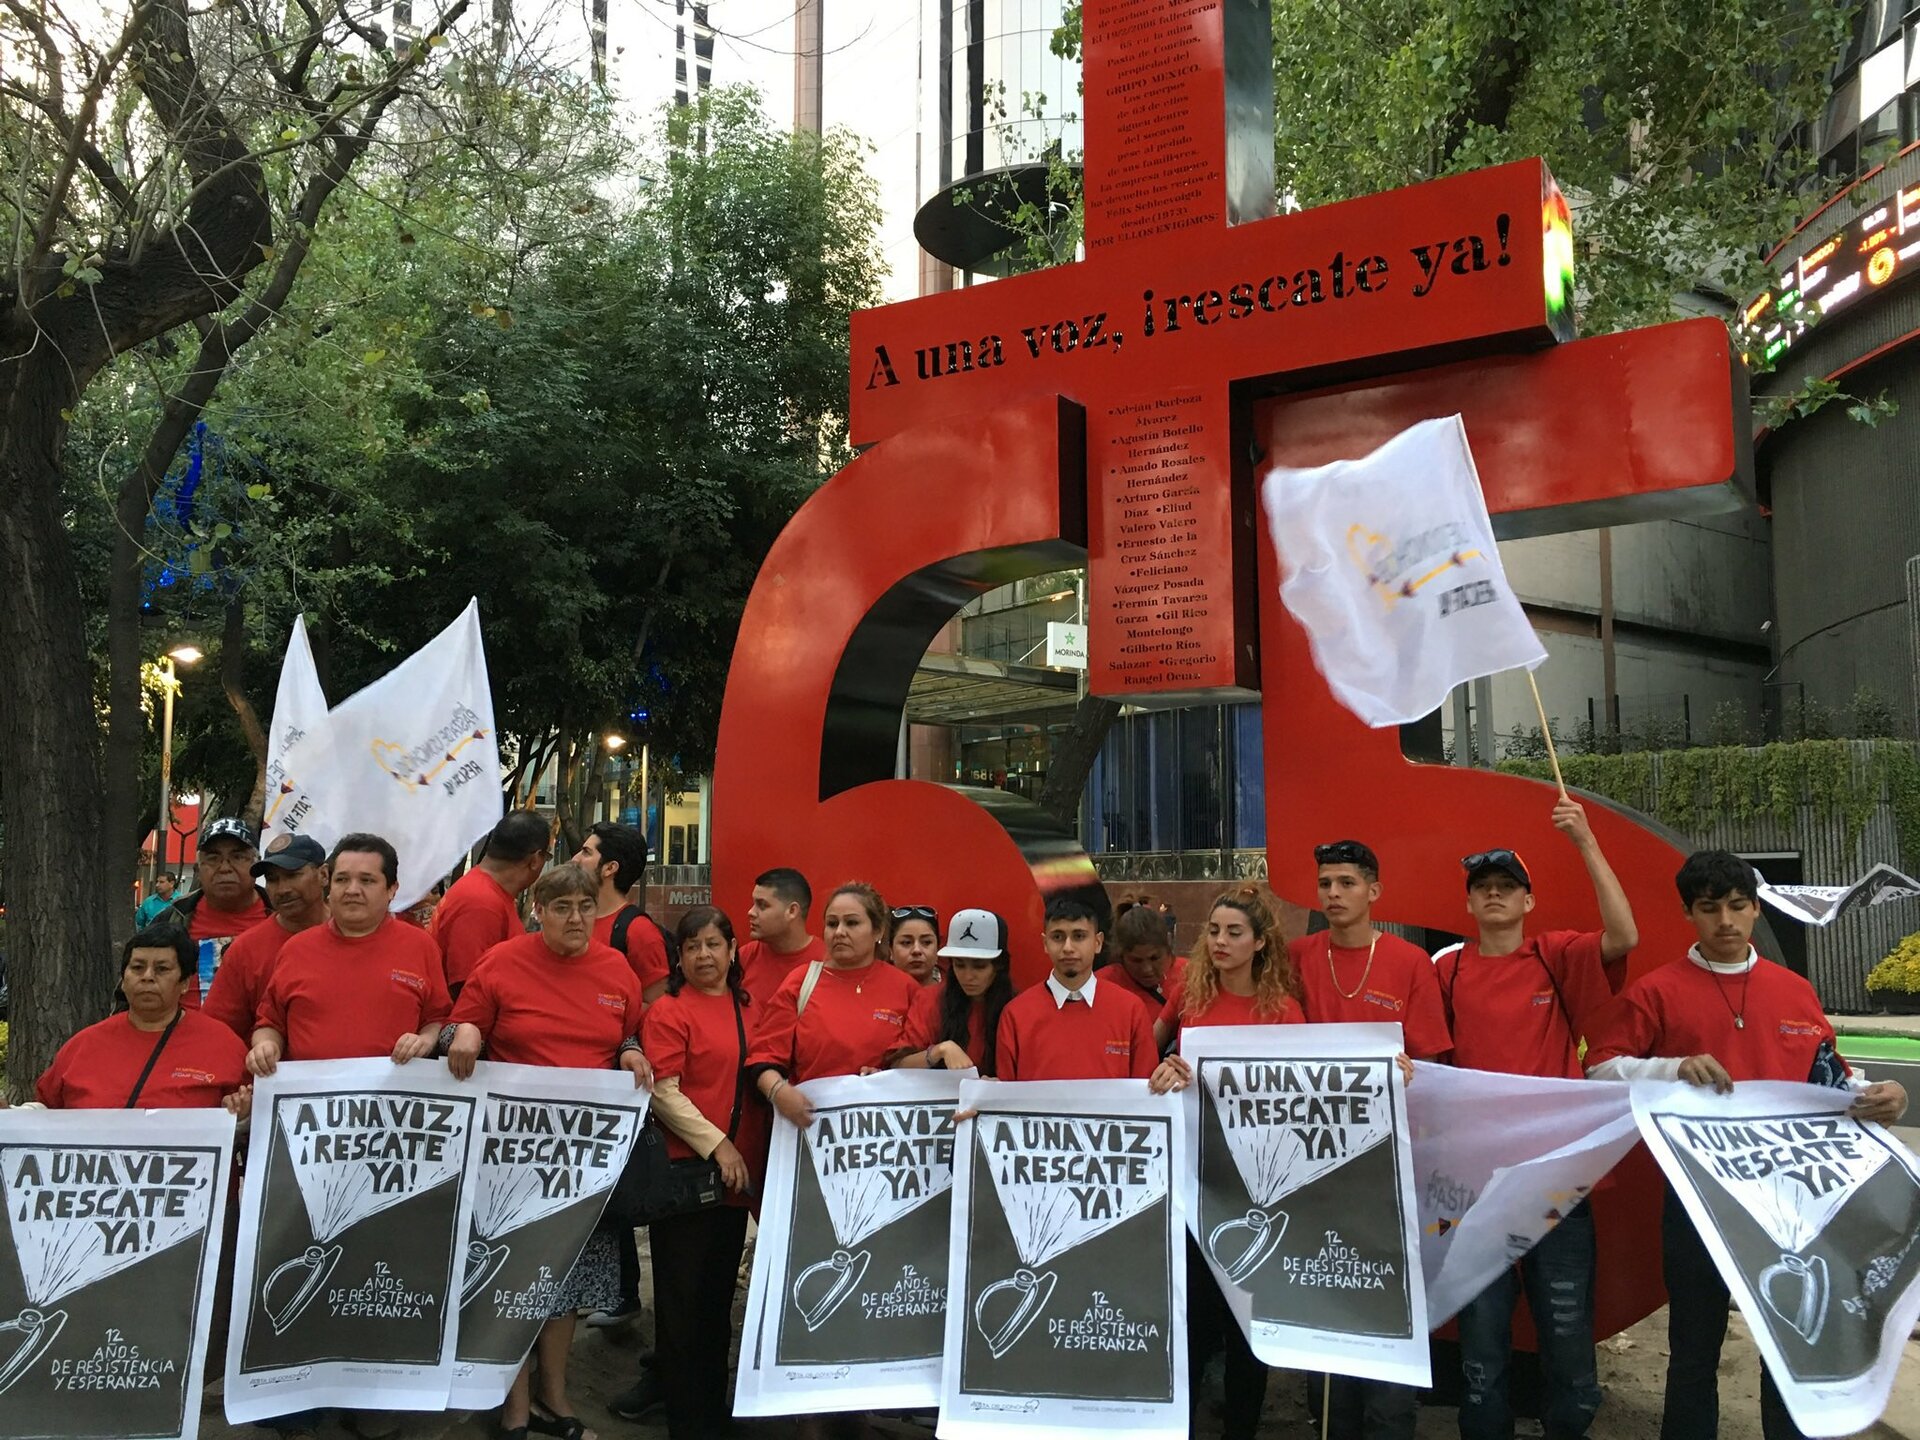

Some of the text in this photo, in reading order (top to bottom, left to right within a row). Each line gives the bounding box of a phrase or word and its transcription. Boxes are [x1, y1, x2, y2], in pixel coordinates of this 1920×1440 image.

[1167, 23, 1193, 37] mina
[1107, 55, 1135, 68] Pasta
[1117, 50, 1190, 80] propiedad del
[1106, 78, 1148, 97] GRUPO
[1143, 82, 1185, 99] cuerpos
[1117, 108, 1190, 133] siguen dentro
[1124, 134, 1140, 145] del
[1156, 135, 1192, 151] pedido
[1114, 173, 1159, 189] empresa
[1162, 160, 1208, 177] tampoco
[1105, 189, 1150, 203] devuelto
[1152, 184, 1168, 194] los
[1090, 235, 1114, 249] POR
[1118, 227, 1154, 243] ELLOS
[865, 212, 1511, 391] A una voz, ¡rescate ya!
[1155, 394, 1202, 409] Barboza
[1162, 424, 1204, 438] Botello
[1128, 442, 1190, 458] Hernández
[1119, 454, 1206, 475] Amado Rosales
[1127, 472, 1189, 489] Hernández
[1122, 492, 1159, 505] Arturo
[1124, 501, 1192, 519] Díaz Eliud
[1120, 517, 1197, 534] Valero Valero
[1123, 532, 1198, 549] Ernesto de la
[1120, 548, 1197, 565] Cruz Sánchez
[1136, 565, 1188, 578] Feliciano
[1114, 577, 1204, 595] Vázquez Posada
[1118, 597, 1158, 610] Fermín
[1115, 608, 1208, 625] Garza Gil Rico
[1127, 625, 1193, 639] Montelongo
[1055, 649, 1085, 657] MORINDA
[1126, 640, 1201, 654] Gilberto Ríos
[1109, 654, 1217, 671] Salazar Gregorio
[1124, 672, 1163, 685] Rangel
[1218, 1065, 1385, 1099] A UNA VOZ,
[294, 1102, 321, 1136] A
[326, 1098, 380, 1129] UNA
[388, 1098, 464, 1138] VOZ,
[1227, 1096, 1370, 1129] ¡RESCATE
[500, 1105, 551, 1135] UNA
[559, 1108, 629, 1147] VOZ,
[815, 1108, 957, 1149] A UNA VOZ
[992, 1121, 1163, 1159] A UNA VOZ,
[1293, 1128, 1348, 1161] YA!
[1680, 1119, 1863, 1154] A UNA VOZ,
[299, 1133, 447, 1166] ¡RESCATE
[482, 1136, 614, 1169] RESCATE
[13, 1153, 208, 1190] A UNA VOZ,
[365, 1162, 417, 1194] YA!
[1000, 1154, 1149, 1186] ¡RESCATE
[534, 1166, 584, 1199] YA!
[883, 1168, 931, 1201] YA!
[1782, 1163, 1856, 1201] YA!
[17, 1188, 189, 1223] ¡RESCATE
[1067, 1186, 1124, 1221] YA!
[95, 1219, 157, 1256] YA!
[1324, 1230, 1343, 1245] 12
[1318, 1243, 1360, 1261] AÑOS
[374, 1260, 391, 1275] 12
[539, 1265, 552, 1279] 12
[902, 1264, 917, 1277] 12
[1283, 1255, 1301, 1272] DE
[363, 1273, 405, 1291] AÑOS
[528, 1278, 560, 1295] AÑOS
[894, 1276, 930, 1293] AÑOS
[1288, 1272, 1386, 1291] Y ESPERANZA
[328, 1288, 346, 1305] DE
[493, 1289, 511, 1304] DE
[861, 1288, 948, 1307] DE RESISTENC
[1091, 1290, 1109, 1306] 12
[330, 1302, 424, 1320] Y ESPERANZA
[496, 1305, 505, 1318] Y
[865, 1302, 948, 1320] Y ESPERANZA
[1083, 1304, 1125, 1323] AÑOS
[104, 1327, 125, 1344] 12
[1048, 1318, 1067, 1335] DE
[92, 1342, 140, 1361] AÑOS
[1053, 1334, 1149, 1353] Y ESPERANZA
[50, 1358, 73, 1376] DE
[54, 1374, 161, 1392] Y ESPERANZA
